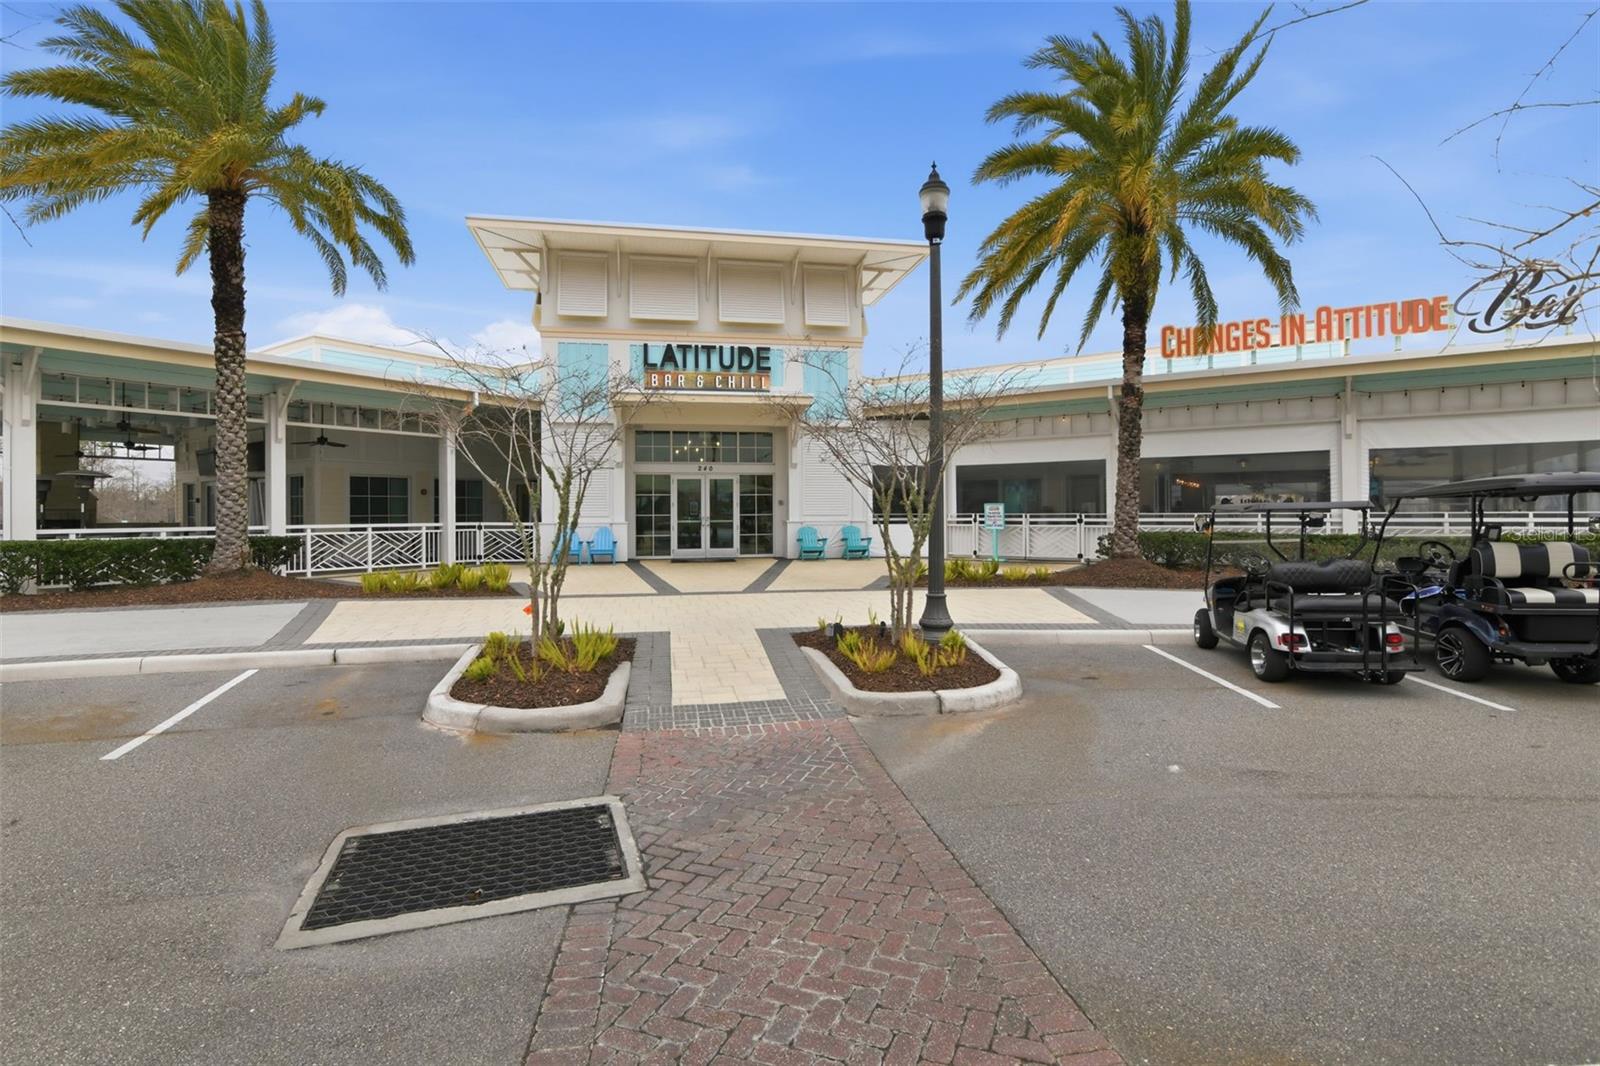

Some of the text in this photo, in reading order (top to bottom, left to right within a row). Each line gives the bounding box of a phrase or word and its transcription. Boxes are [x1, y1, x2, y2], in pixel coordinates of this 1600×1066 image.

[1280, 313, 1305, 346] IN
[1316, 295, 1449, 343] ATTITUDE
[644, 343, 771, 371] LATITUDE
[651, 373, 768, 389] BAR & CHILL
